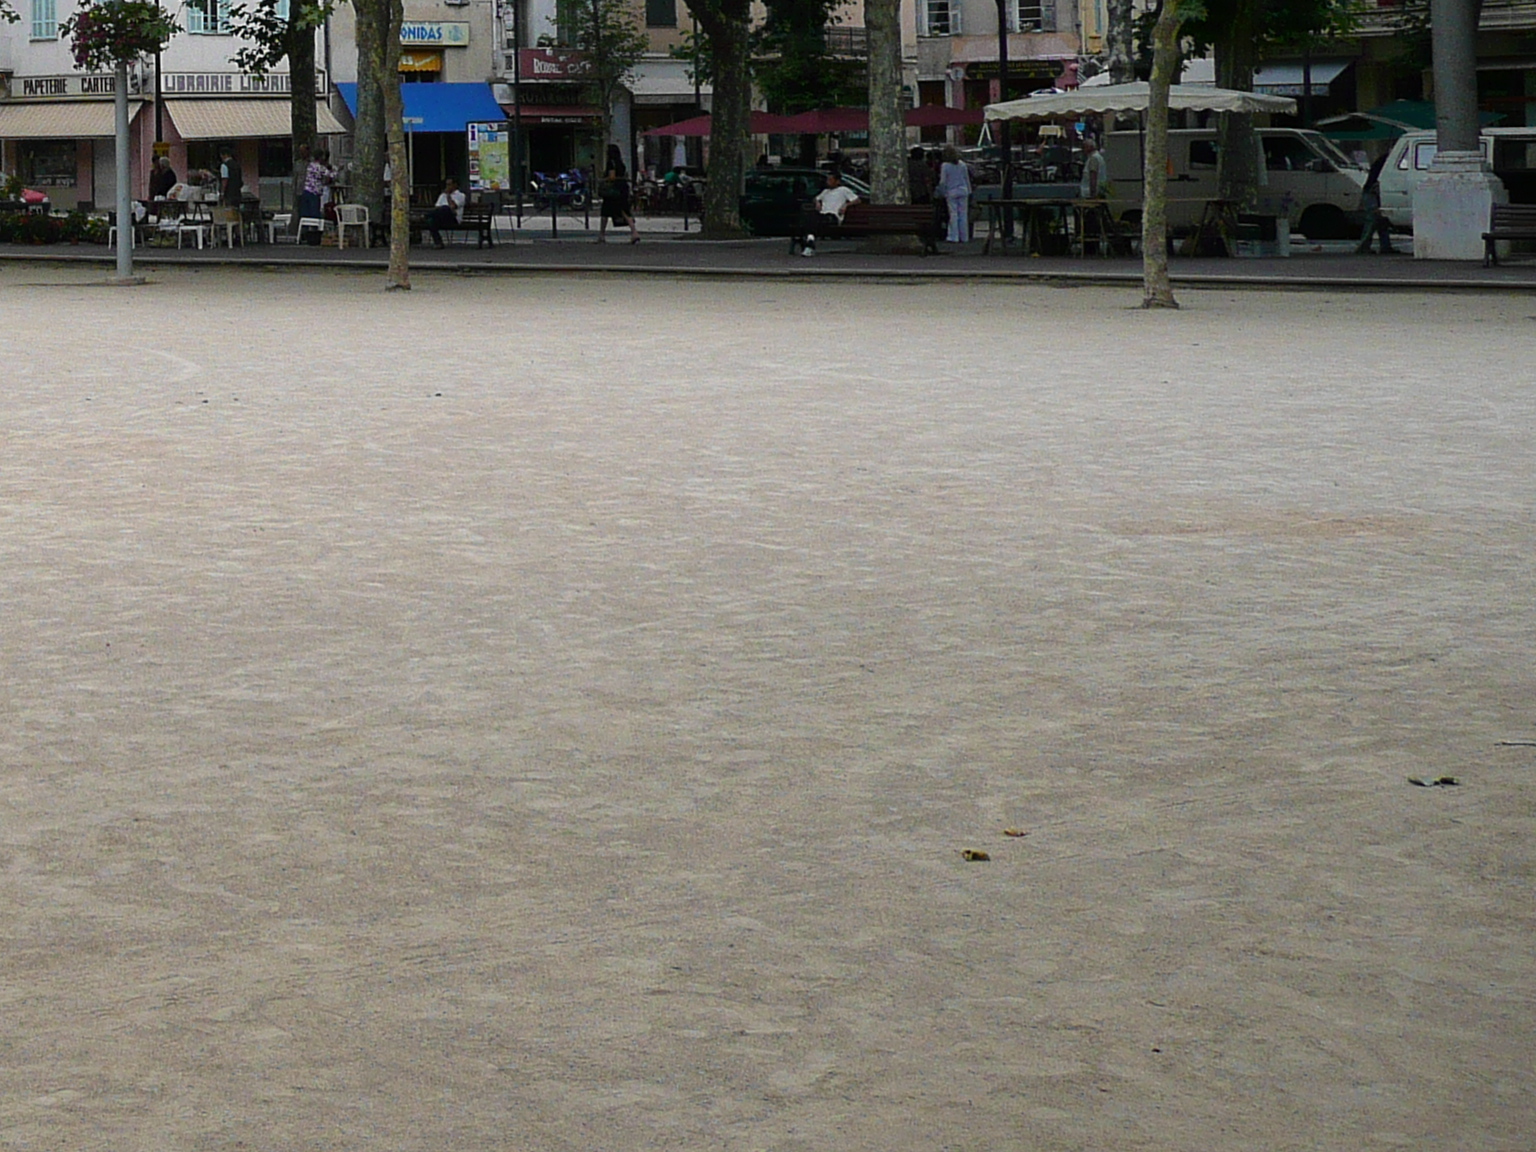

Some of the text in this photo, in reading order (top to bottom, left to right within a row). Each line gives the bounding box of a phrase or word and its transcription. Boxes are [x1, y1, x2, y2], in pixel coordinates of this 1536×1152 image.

[400, 25, 443, 41] ONIDAS
[23, 77, 116, 95] PAPETERIE CARTER
[164, 74, 321, 93] LIBRAIRIE LIGURIEE
